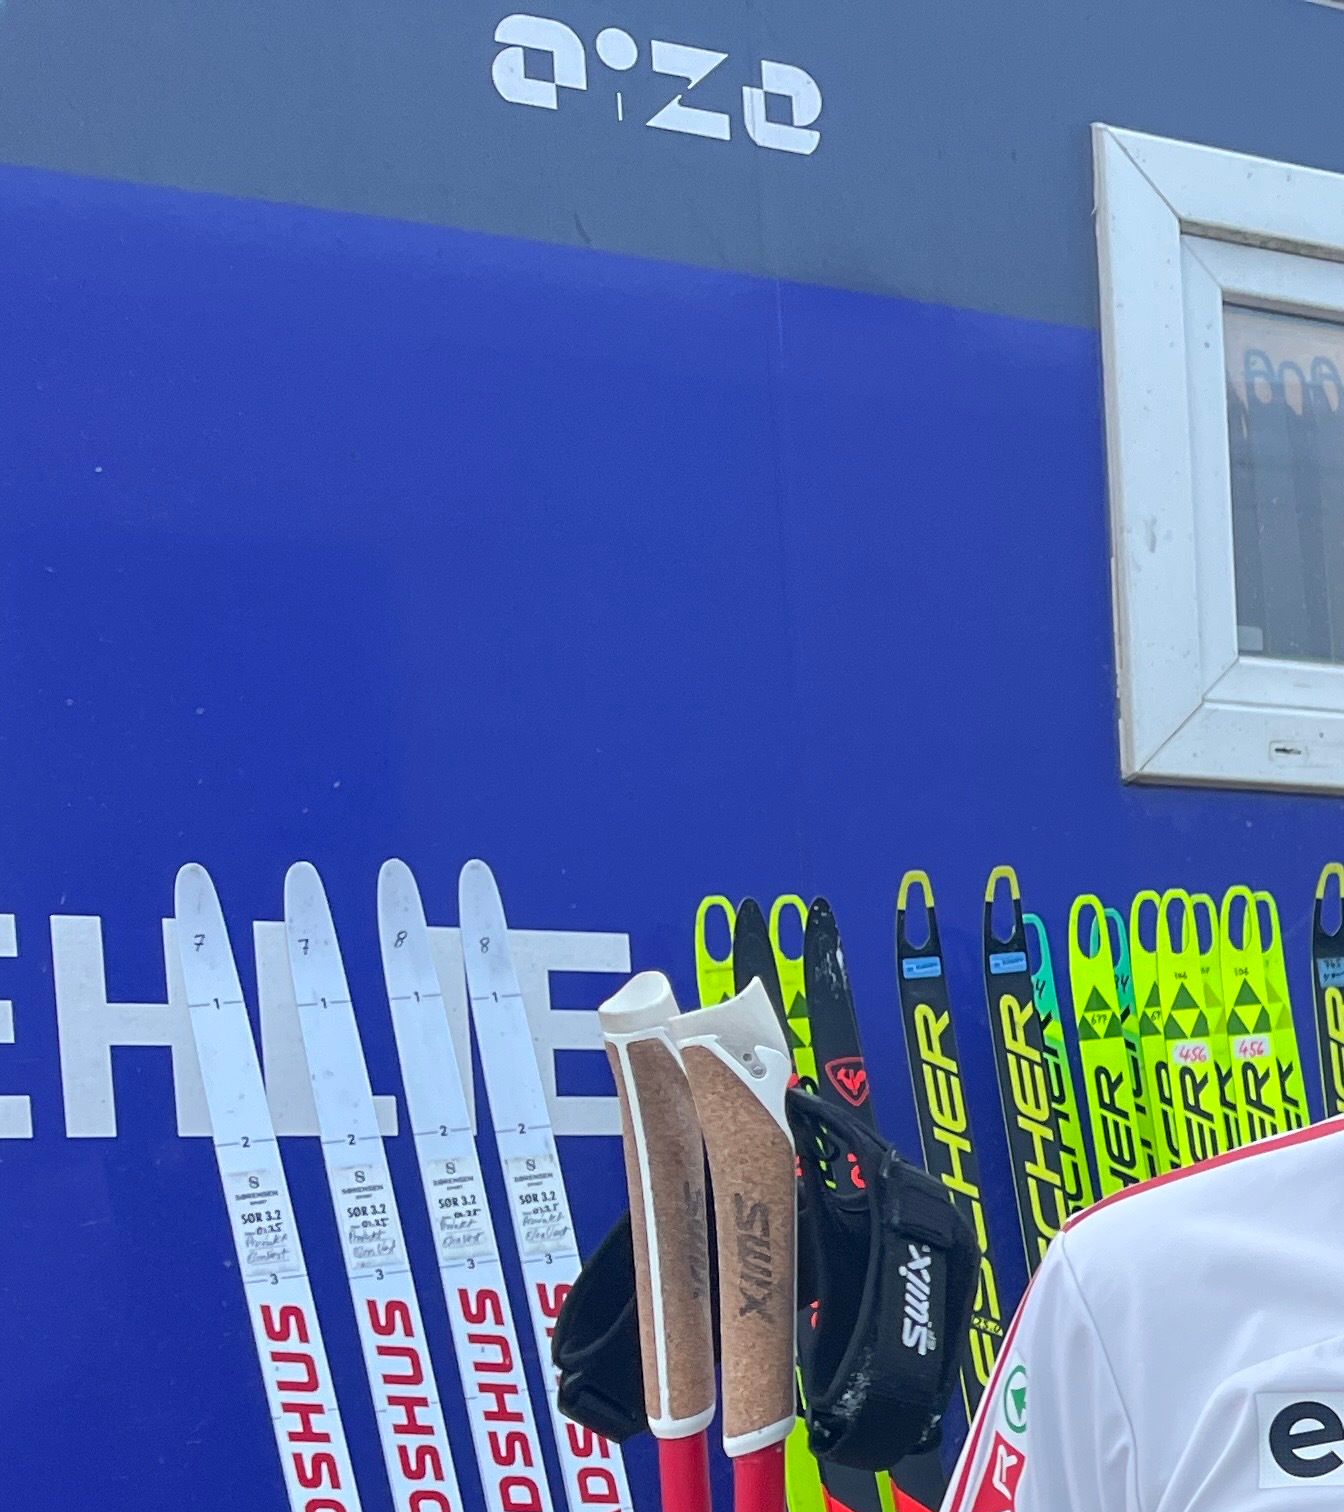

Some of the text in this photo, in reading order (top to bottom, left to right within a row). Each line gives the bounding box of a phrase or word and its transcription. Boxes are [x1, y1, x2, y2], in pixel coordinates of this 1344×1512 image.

[467, 1258, 475, 1269] 3
[545, 1254, 553, 1265] 3
[268, 1274, 278, 1285] 3
[375, 1269, 384, 1280] 3
